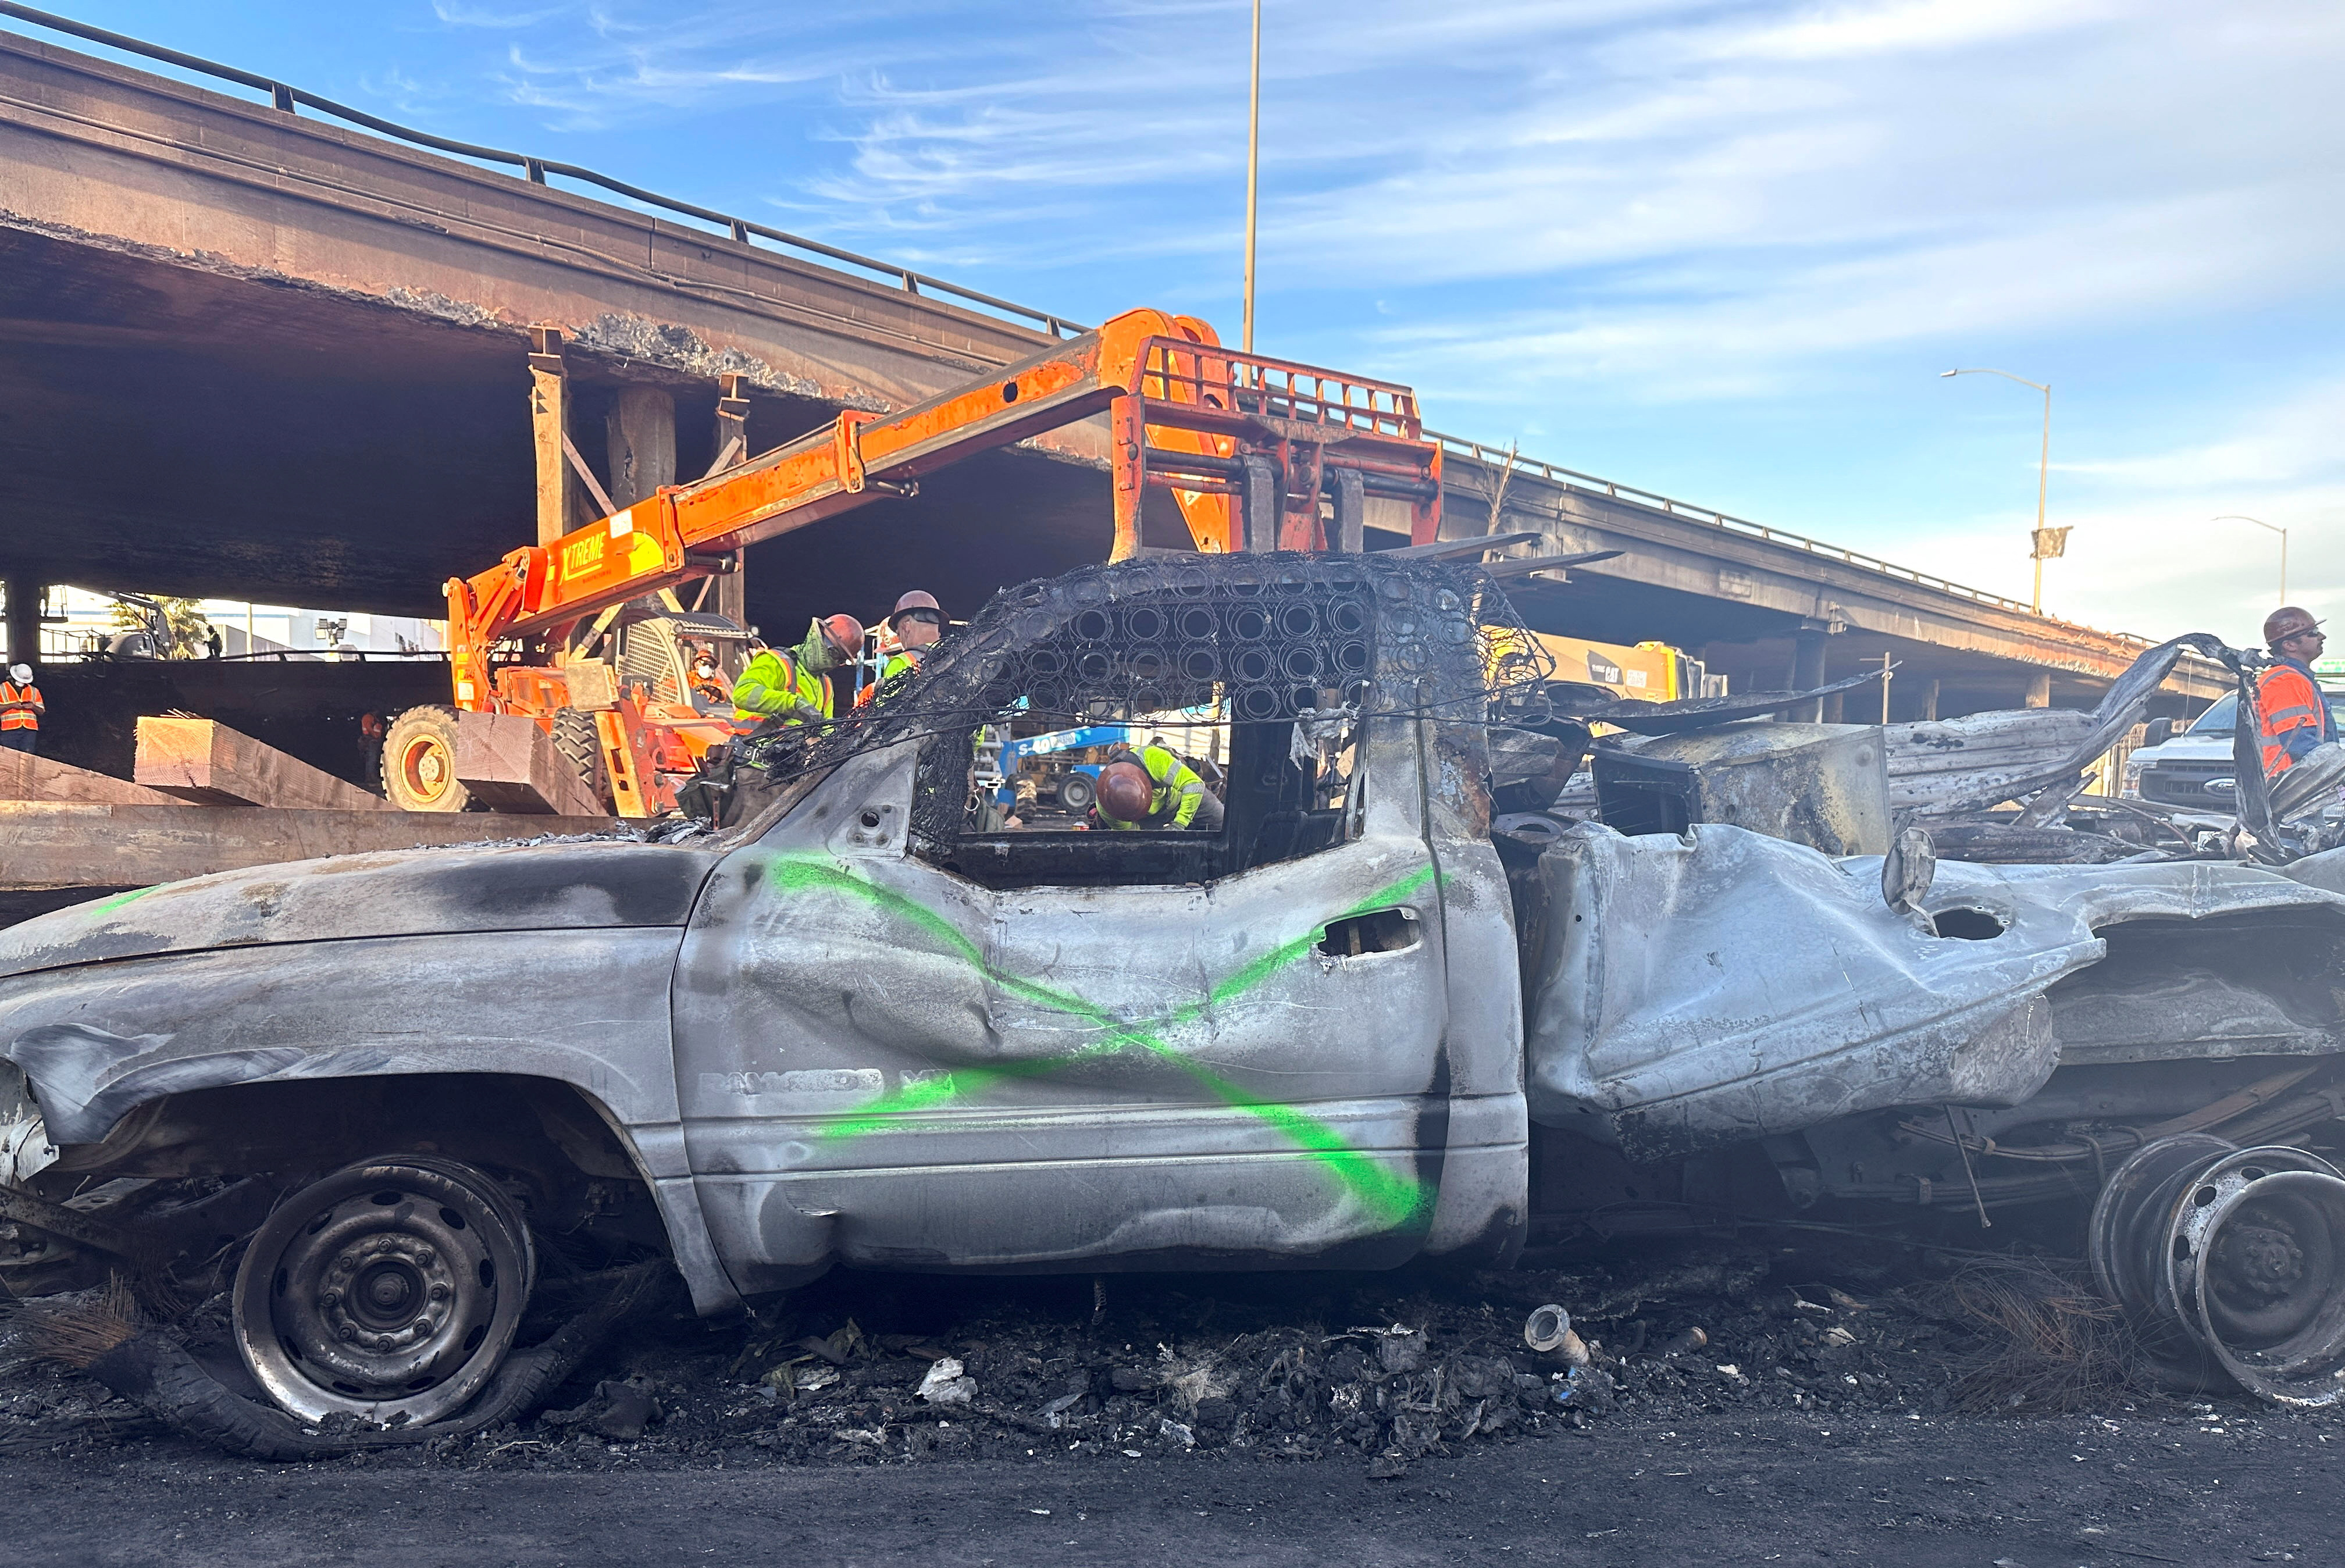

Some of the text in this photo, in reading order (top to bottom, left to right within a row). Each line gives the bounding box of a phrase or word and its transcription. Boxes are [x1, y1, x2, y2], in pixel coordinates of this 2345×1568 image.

[558, 530, 606, 586] XTREME
[1605, 666, 1619, 683] CAT
[1018, 739, 1050, 756] S-40
